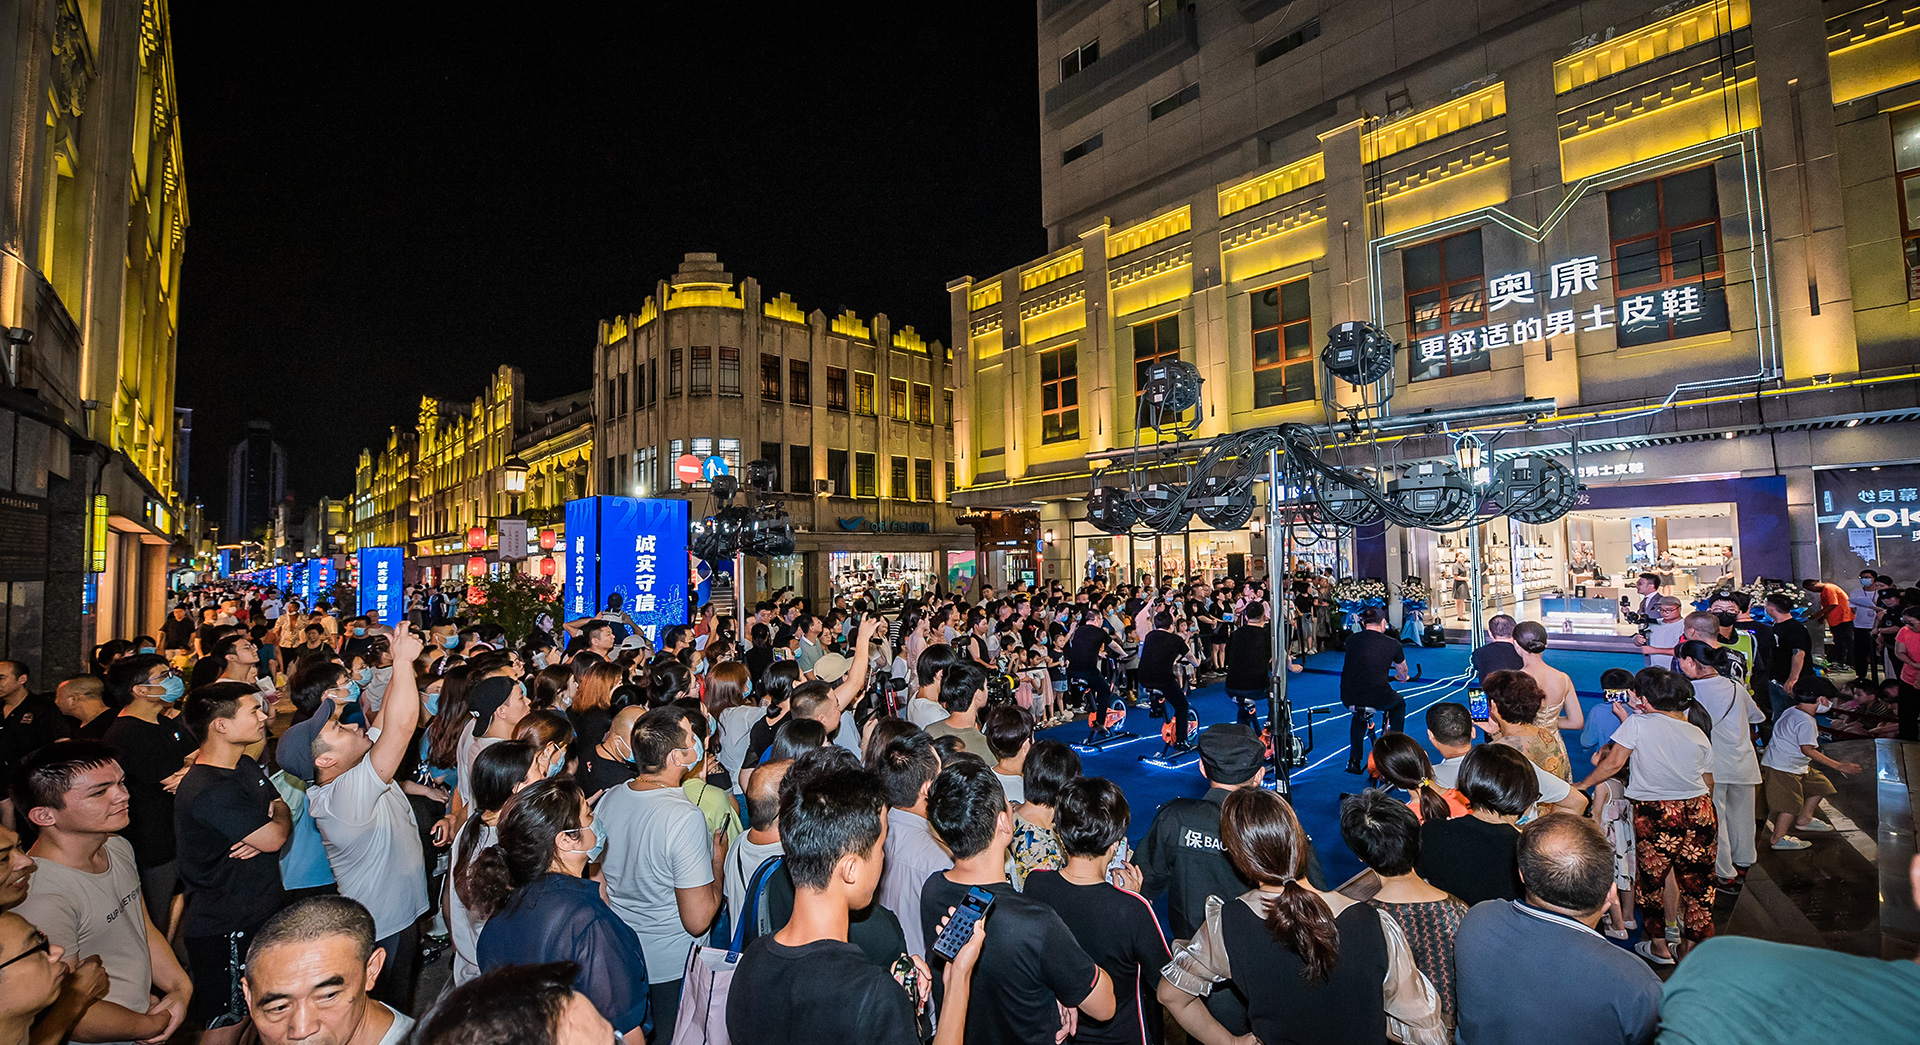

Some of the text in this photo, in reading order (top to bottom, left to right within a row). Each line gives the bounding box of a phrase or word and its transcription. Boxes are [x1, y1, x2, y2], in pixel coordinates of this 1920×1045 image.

[1489, 255, 1600, 312] 奥康
[1419, 286, 1701, 363] 更舒适的男士皮鞋
[611, 496, 679, 534] 2021
[634, 534, 657, 613] 诚实守信
[1184, 829, 1203, 849] 保
